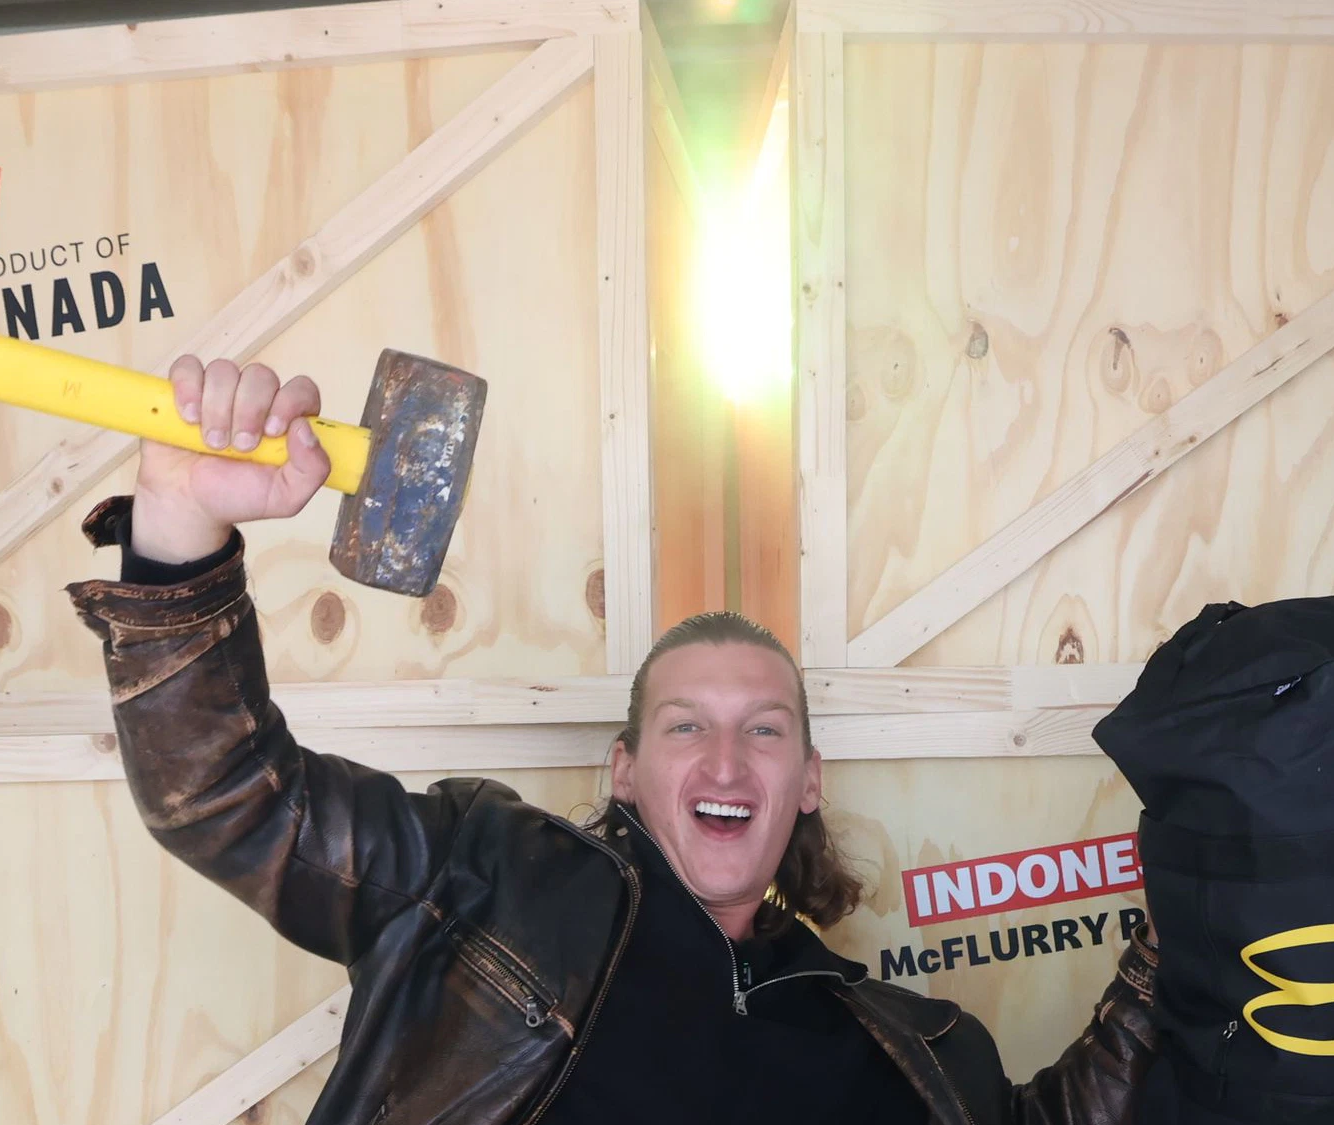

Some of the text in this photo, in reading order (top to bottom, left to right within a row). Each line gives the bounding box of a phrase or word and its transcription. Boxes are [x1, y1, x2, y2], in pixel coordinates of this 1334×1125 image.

[96, 233, 131, 260] OF
[911, 838, 1143, 918] INDONE
[880, 912, 1109, 981] McFLURRY
